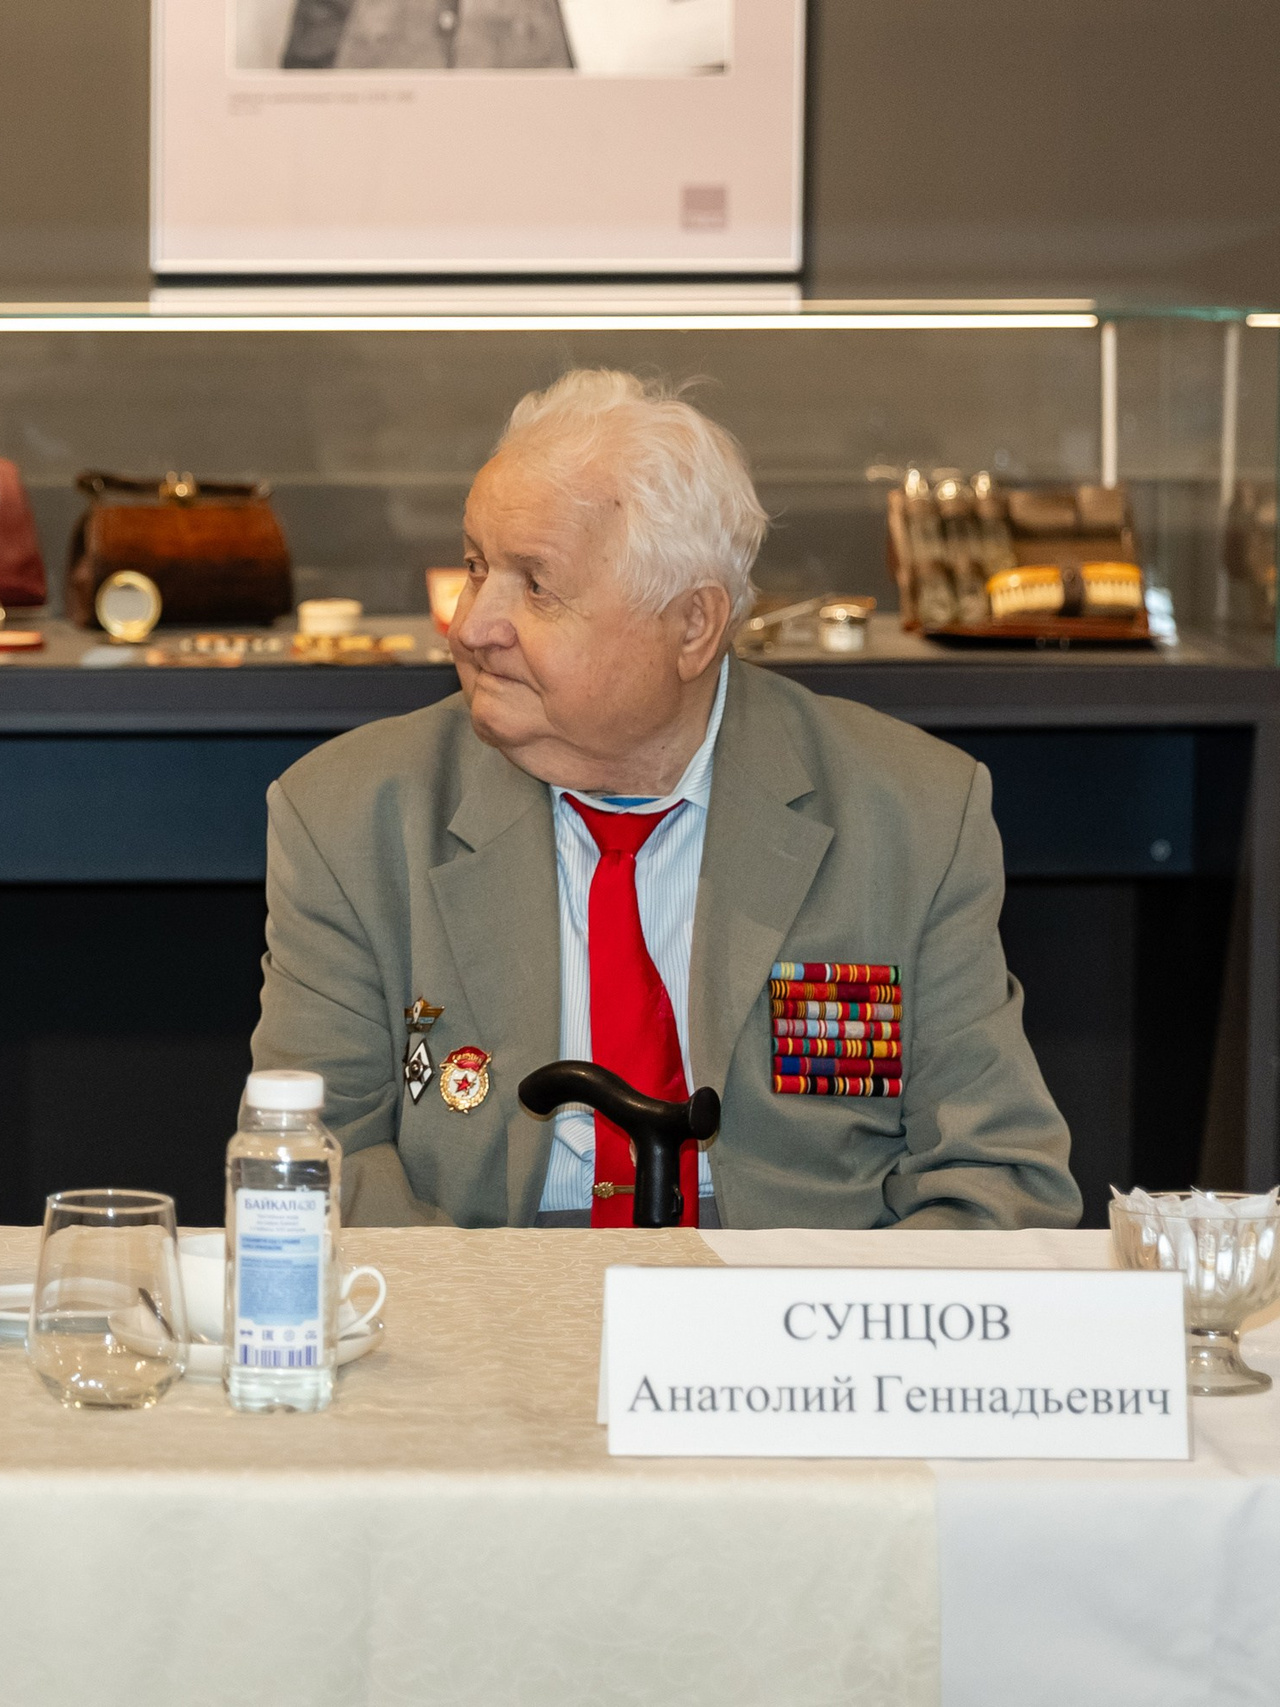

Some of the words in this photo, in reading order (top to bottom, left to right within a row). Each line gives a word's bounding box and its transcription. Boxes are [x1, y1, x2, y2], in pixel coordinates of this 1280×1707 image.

[783, 1302, 1011, 1349] СУНЦОВ
[629, 1375, 856, 1413] Анатолий
[875, 1375, 1172, 1418] Геннадьевич
